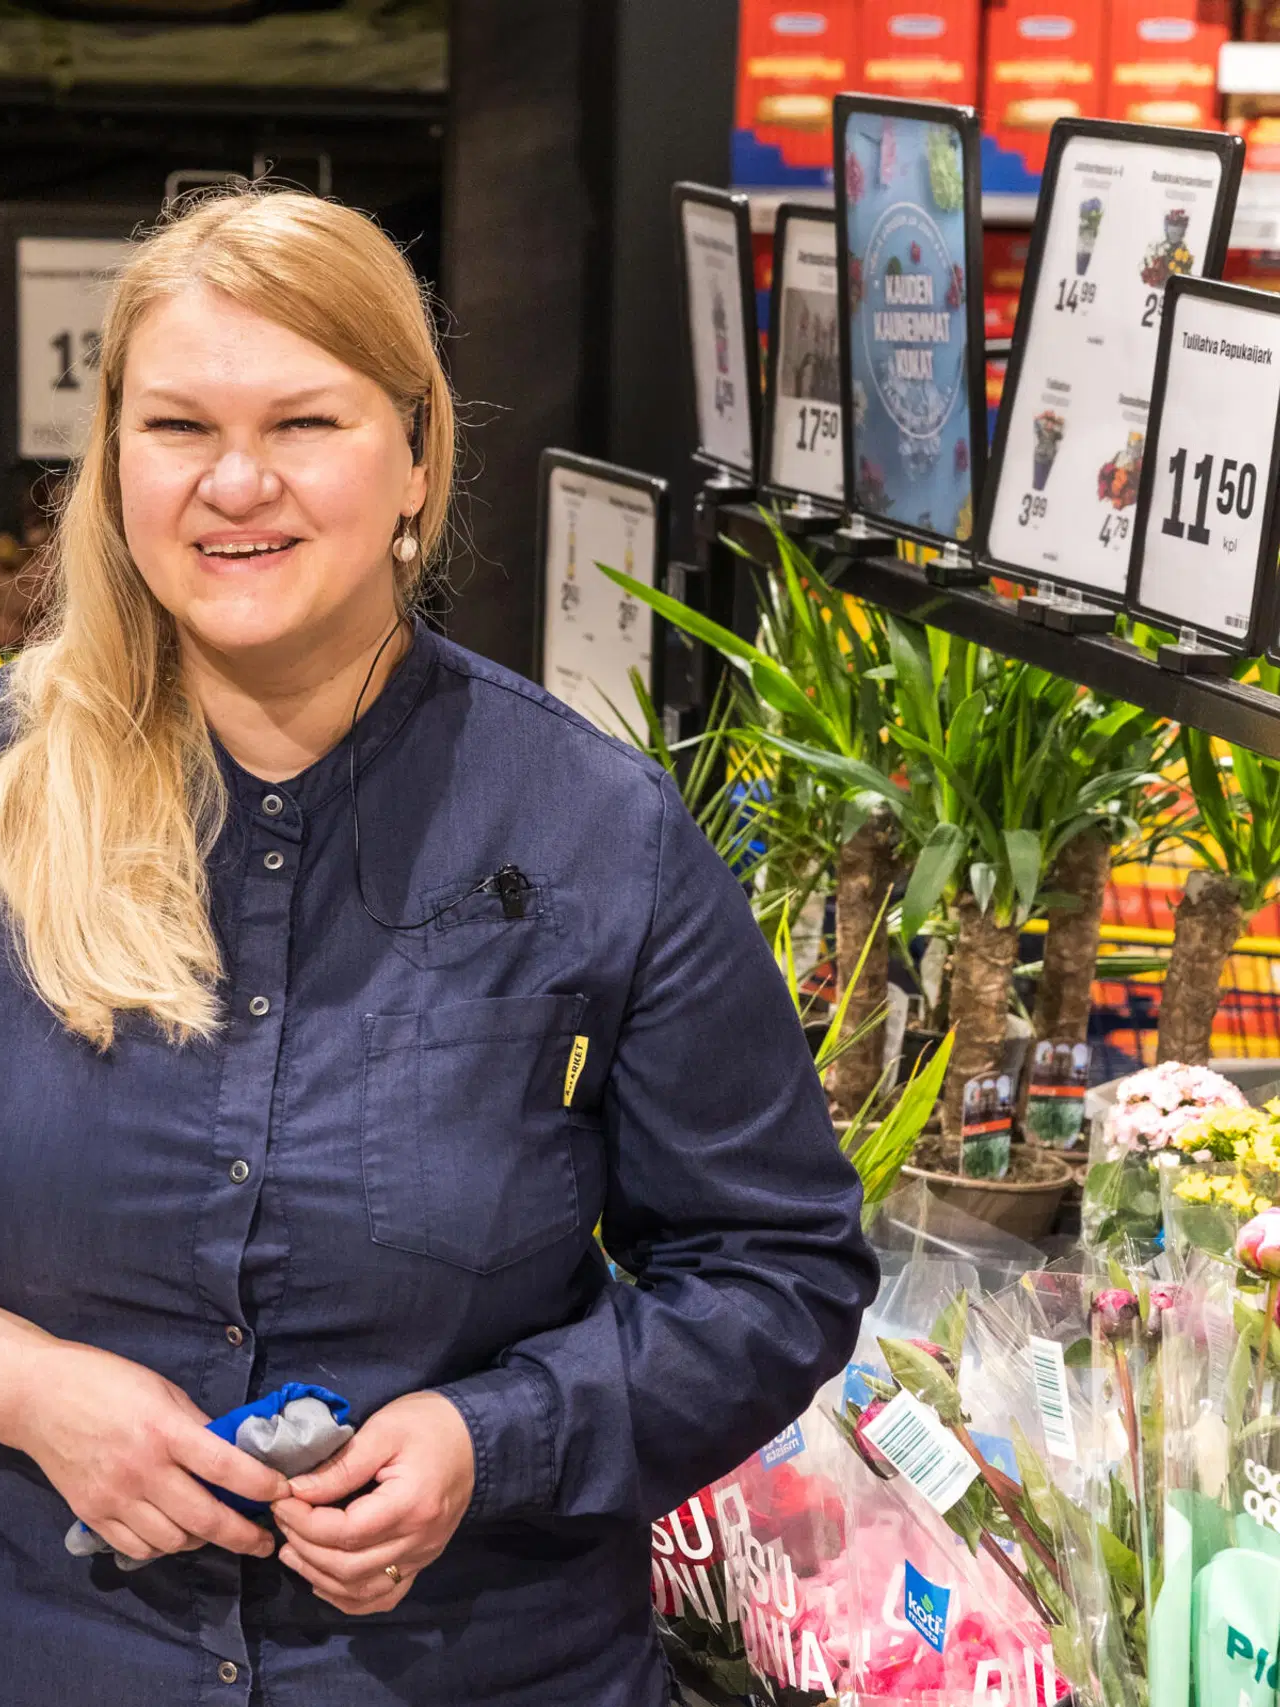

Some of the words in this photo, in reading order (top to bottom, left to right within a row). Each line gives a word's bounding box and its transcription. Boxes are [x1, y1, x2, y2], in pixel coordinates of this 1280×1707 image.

[884, 274, 934, 304] KAUDEN
[1182, 331, 1219, 356] Tulilatva
[1222, 536, 1238, 555] kpl
